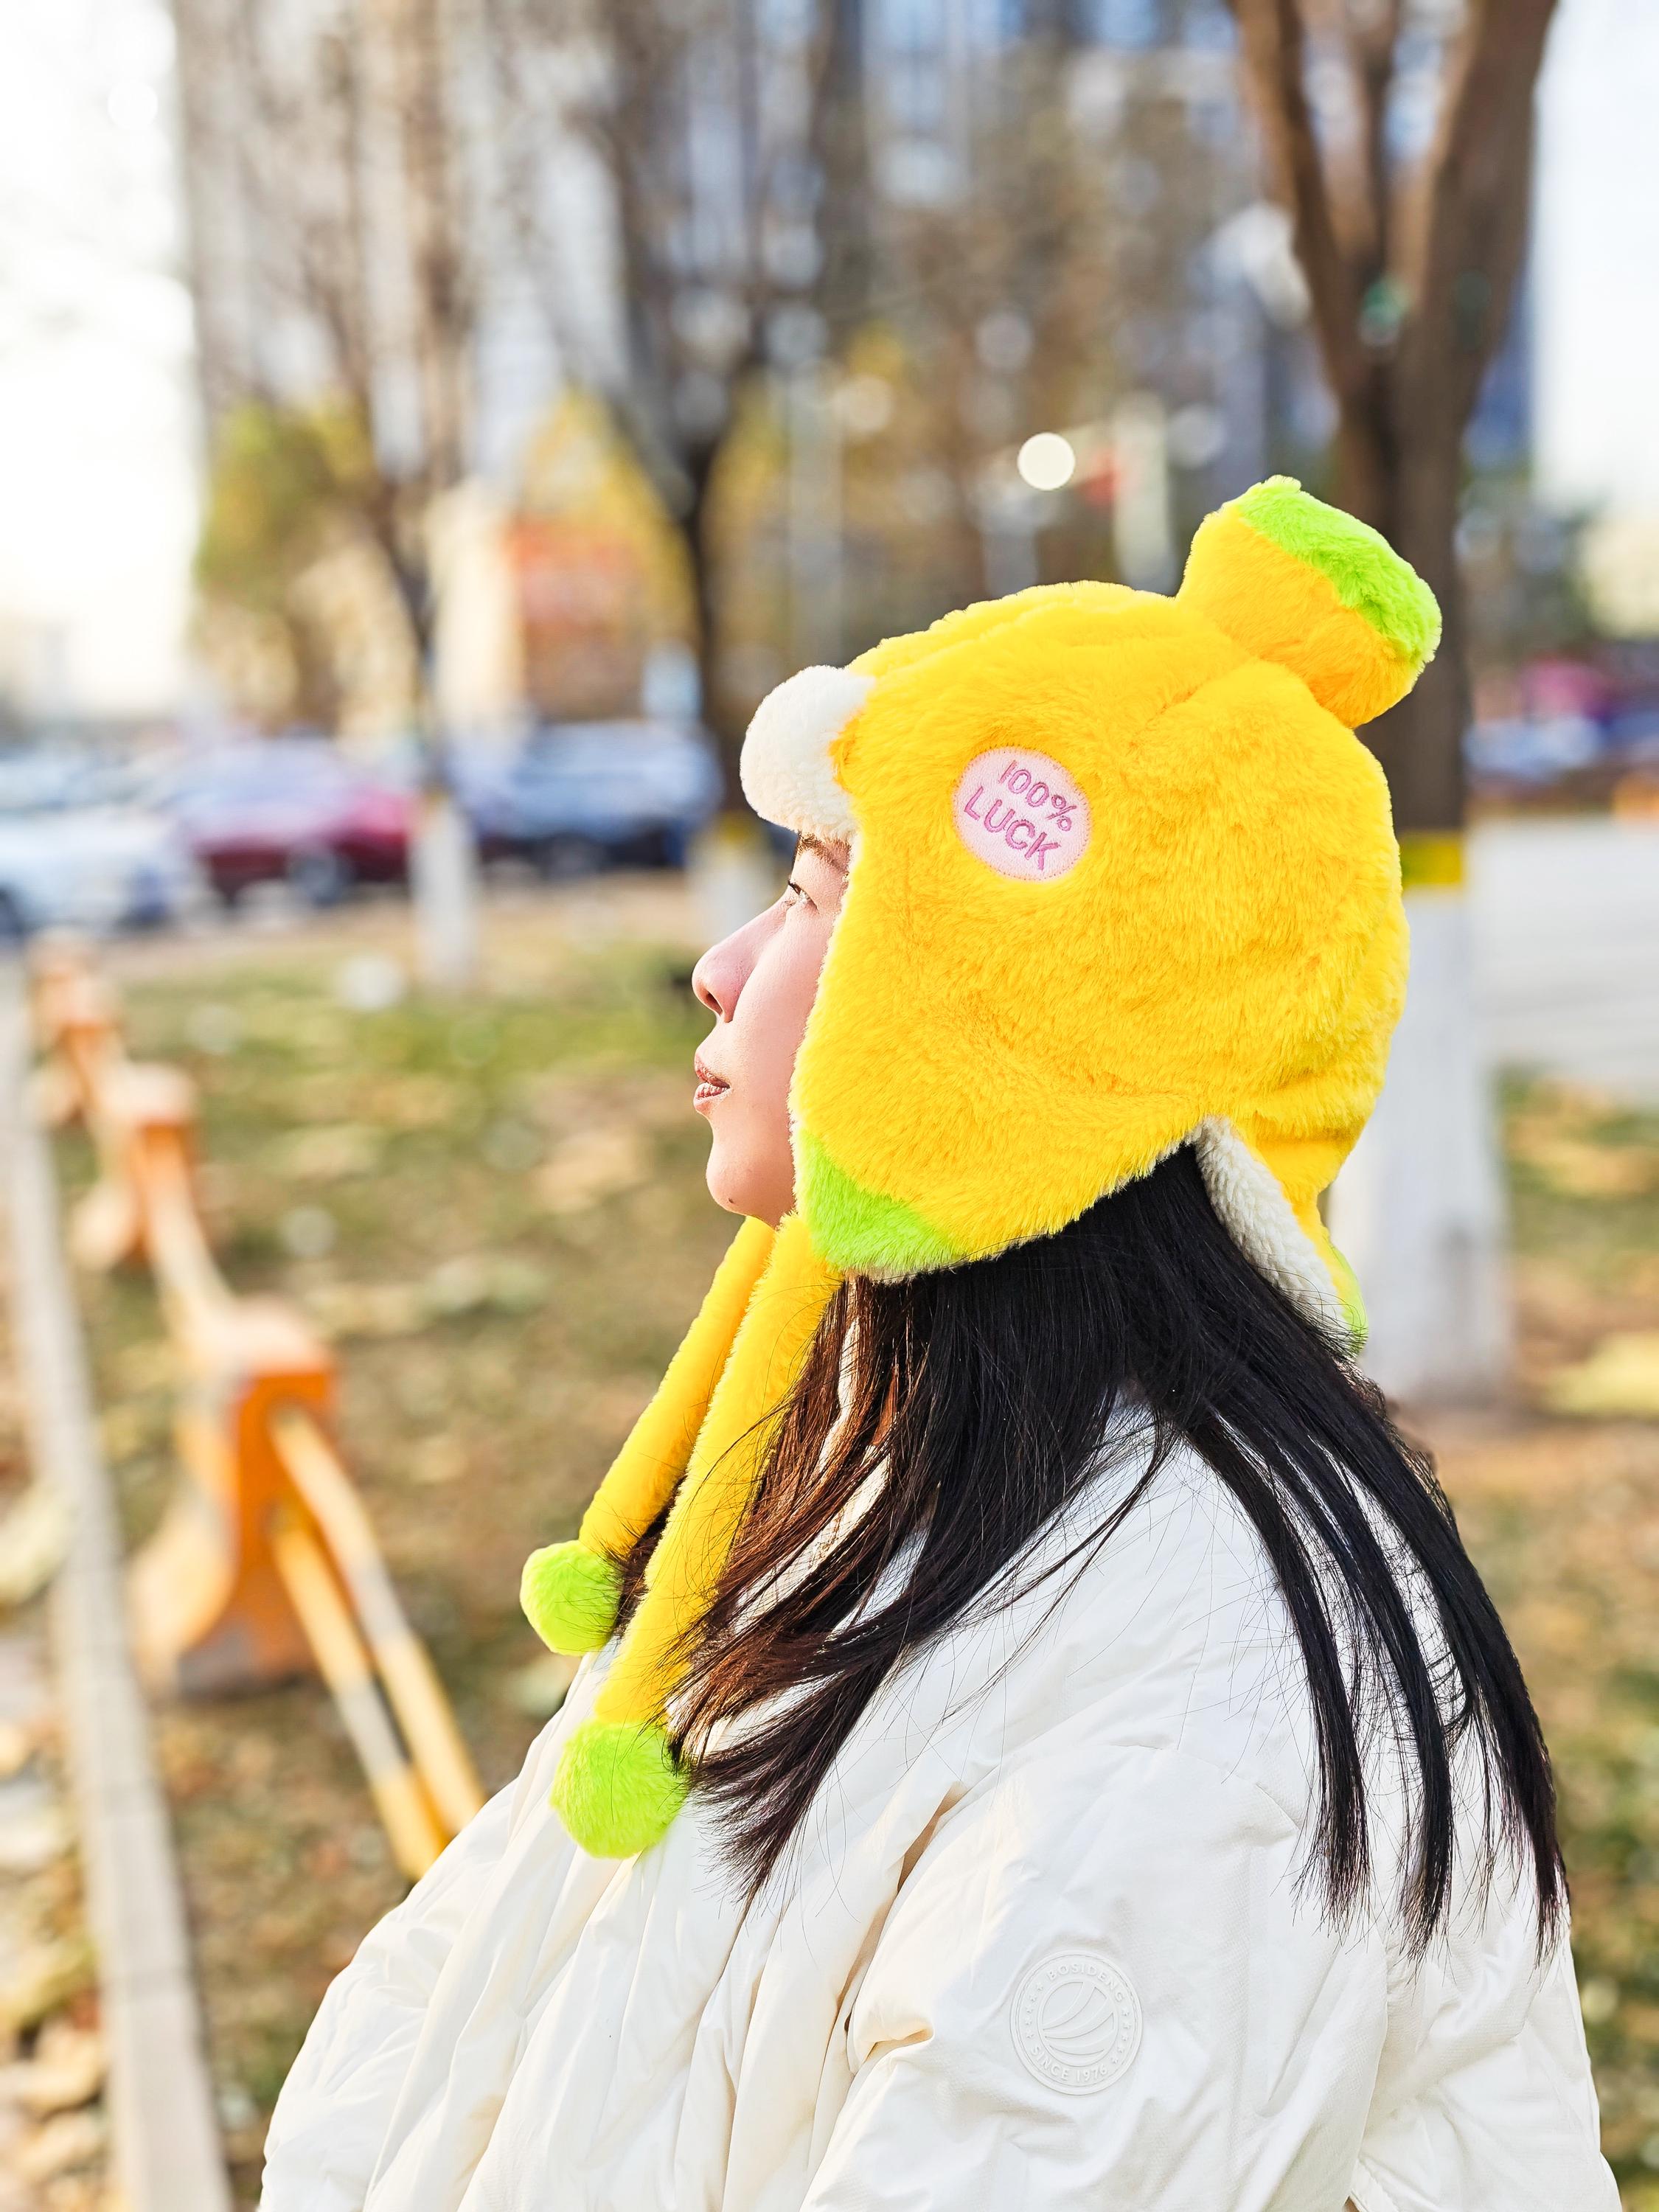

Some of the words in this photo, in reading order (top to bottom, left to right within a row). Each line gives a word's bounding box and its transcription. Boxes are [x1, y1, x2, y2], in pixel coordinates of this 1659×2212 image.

[998, 759, 1077, 831] 100%
[964, 786, 1060, 870] LUCK
[1046, 1963, 1124, 2003] BOSIDENG
[1031, 2045, 1068, 2081] SINCE
[1076, 2062, 1107, 2083] 1976
